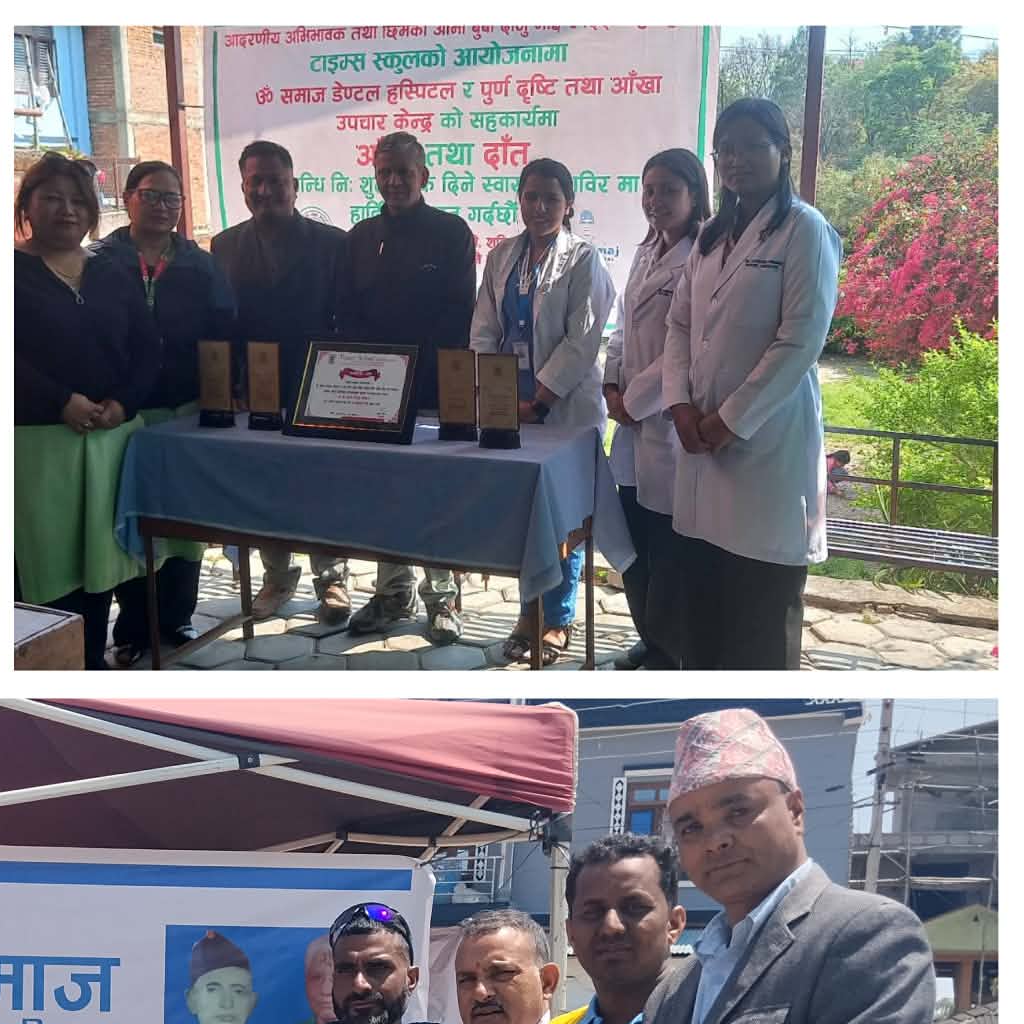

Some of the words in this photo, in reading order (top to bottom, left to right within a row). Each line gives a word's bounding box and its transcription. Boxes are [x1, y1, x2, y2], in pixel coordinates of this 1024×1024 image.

[225, 31, 280, 48] आदरणीय
[310, 53, 366, 74] टाइम्स
[372, 44, 446, 74] स्कुलको
[454, 41, 568, 66] आयोजनामा
[280, 87, 327, 105] समाज
[332, 82, 381, 102] डेण्टल
[386, 79, 457, 104] हस्पिटल
[462, 82, 474, 98] र
[480, 72, 513, 104] पुर्ण
[516, 73, 559, 104] दृष्टि
[564, 76, 606, 96] तथा
[611, 70, 663, 95] आँखा
[336, 113, 387, 131] उपचार
[393, 108, 434, 133] केन्द्र
[440, 107, 464, 129] को
[470, 105, 560, 132] सहकार्यमा
[425, 143, 474, 167] तथा
[483, 135, 531, 171] दाँत
[442, 170, 476, 196] दिने
[618, 176, 640, 193] मा
